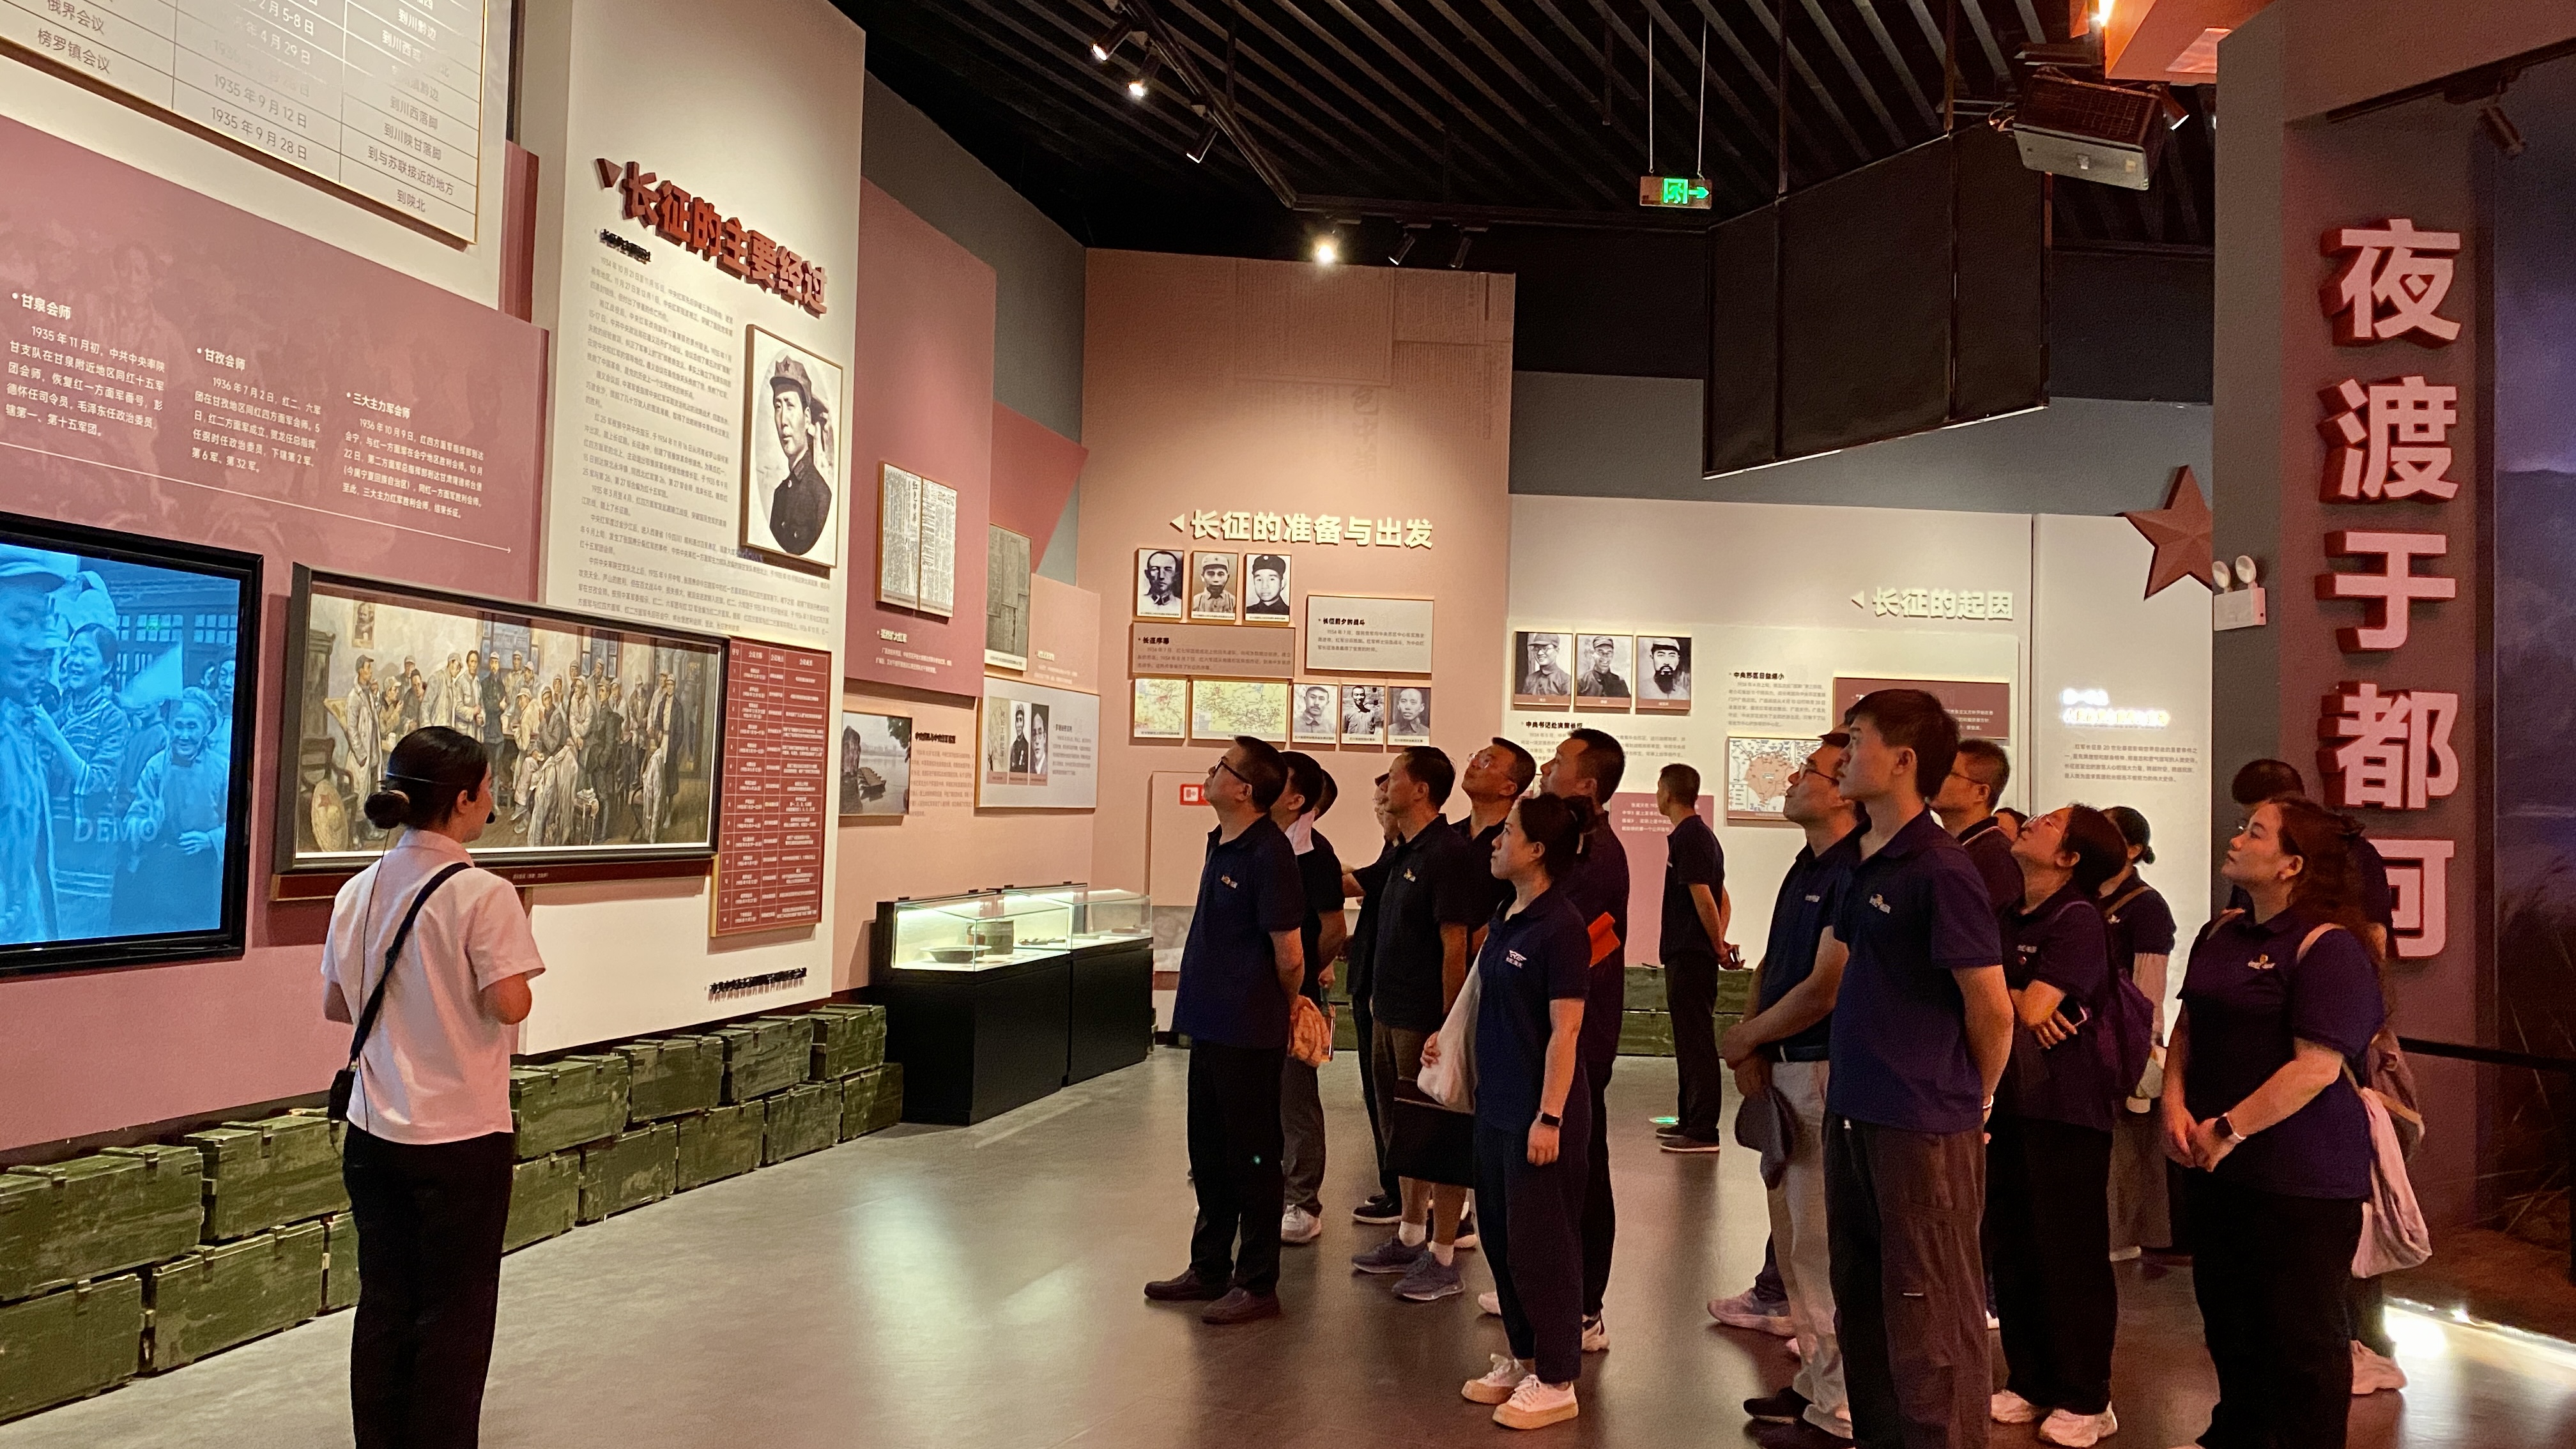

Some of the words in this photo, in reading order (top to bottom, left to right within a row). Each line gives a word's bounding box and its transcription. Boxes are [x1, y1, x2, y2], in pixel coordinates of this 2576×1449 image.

[38, 27, 111, 75] 榜罗镇会议
[211, 106, 307, 161] 1935年9月28日
[367, 145, 455, 196] 到与苏联接近的地方
[397, 188, 426, 213] 到陕北
[619, 161, 827, 320] 长征的主要经过
[21, 293, 72, 320] 甘泉会师
[204, 348, 246, 371] 甘孜会师
[353, 392, 411, 420] 三大主力军会师
[1190, 509, 1434, 549] 长征的准备与出发
[1871, 586, 2014, 621] 长征的起因
[73, 816, 159, 843] DEMO
